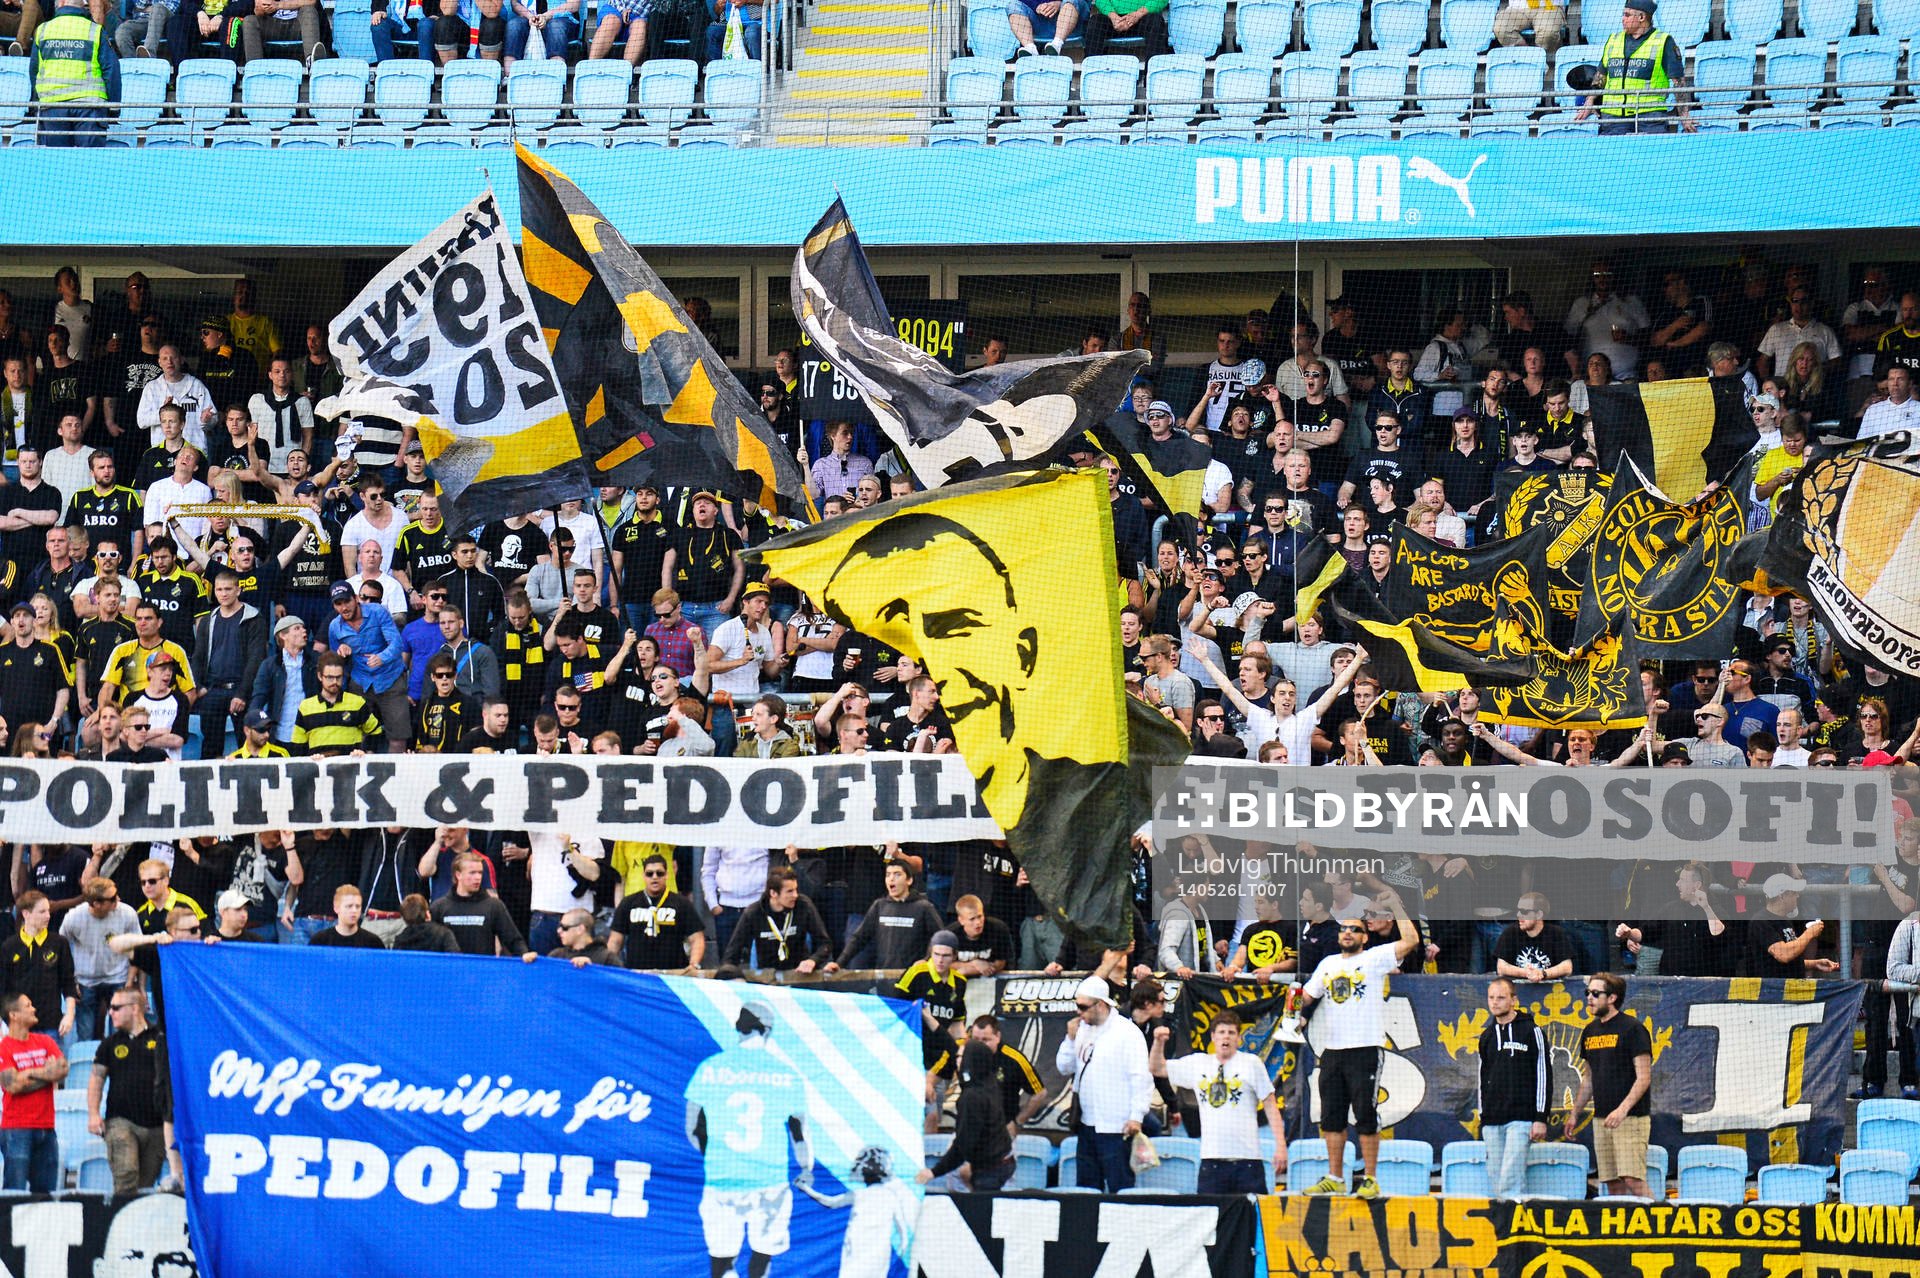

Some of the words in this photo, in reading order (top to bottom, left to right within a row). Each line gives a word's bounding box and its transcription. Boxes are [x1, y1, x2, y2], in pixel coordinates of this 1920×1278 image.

[44, 39, 85, 49] ORDNINGS
[54, 50, 73, 59] VAKT
[1196, 155, 1400, 223] PUMA
[84, 512, 118, 526] ÅBRO
[417, 553, 452, 569] ÅBRO
[1411, 564, 1444, 587] ARE
[0, 761, 397, 829] POLITIK
[424, 761, 495, 824] &
[523, 758, 993, 827] PEDOFIL
[208, 1048, 561, 1132] Mff-Familjen
[563, 1076, 652, 1134] för
[722, 1091, 764, 1153] 3
[203, 1133, 653, 1218] PEDOFILI
[1257, 1195, 1499, 1272] KAOS
[1510, 1203, 1589, 1236] ALLA
[1600, 1206, 1723, 1236] HATAR
[1734, 1207, 1801, 1237] OSS
